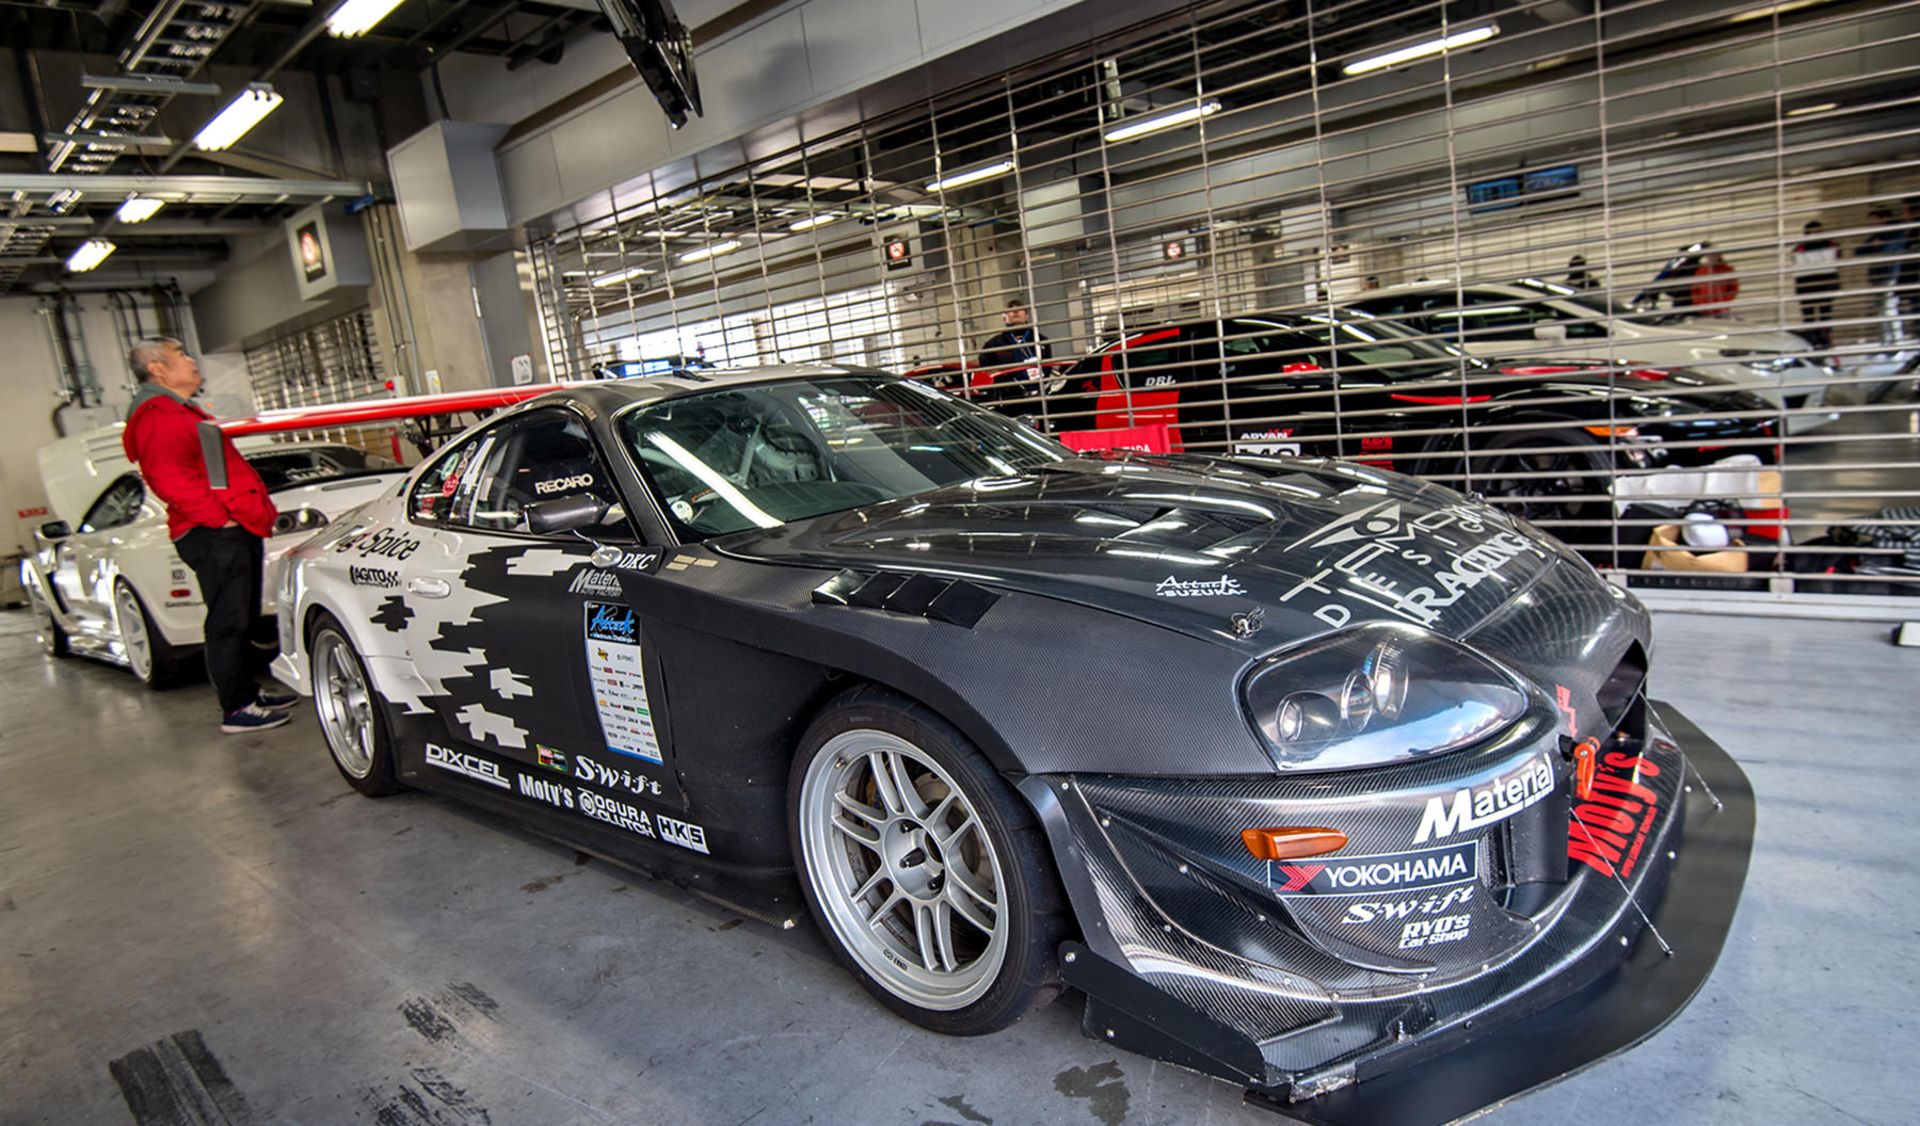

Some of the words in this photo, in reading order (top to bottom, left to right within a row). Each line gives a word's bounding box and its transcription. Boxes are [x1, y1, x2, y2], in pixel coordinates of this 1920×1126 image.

[1240, 432, 1288, 441] ADVAN
[535, 473, 594, 494] RECARO
[356, 527, 421, 561] Spice
[618, 553, 657, 570] DKC
[1394, 531, 1533, 626] RACING
[1156, 574, 1241, 592] Attack
[426, 742, 511, 786] DIXCEL
[575, 755, 662, 796] Swift
[518, 772, 575, 809] Moty's
[1411, 752, 1554, 846] Material
[594, 794, 652, 827] OGURA
[596, 809, 658, 840] CLUTCH
[658, 816, 708, 850] HKS
[1325, 853, 1467, 888] YOKOHAMA
[1341, 886, 1474, 925] Swift
[1399, 936, 1428, 949] Car
[1428, 928, 1470, 945] Shop
